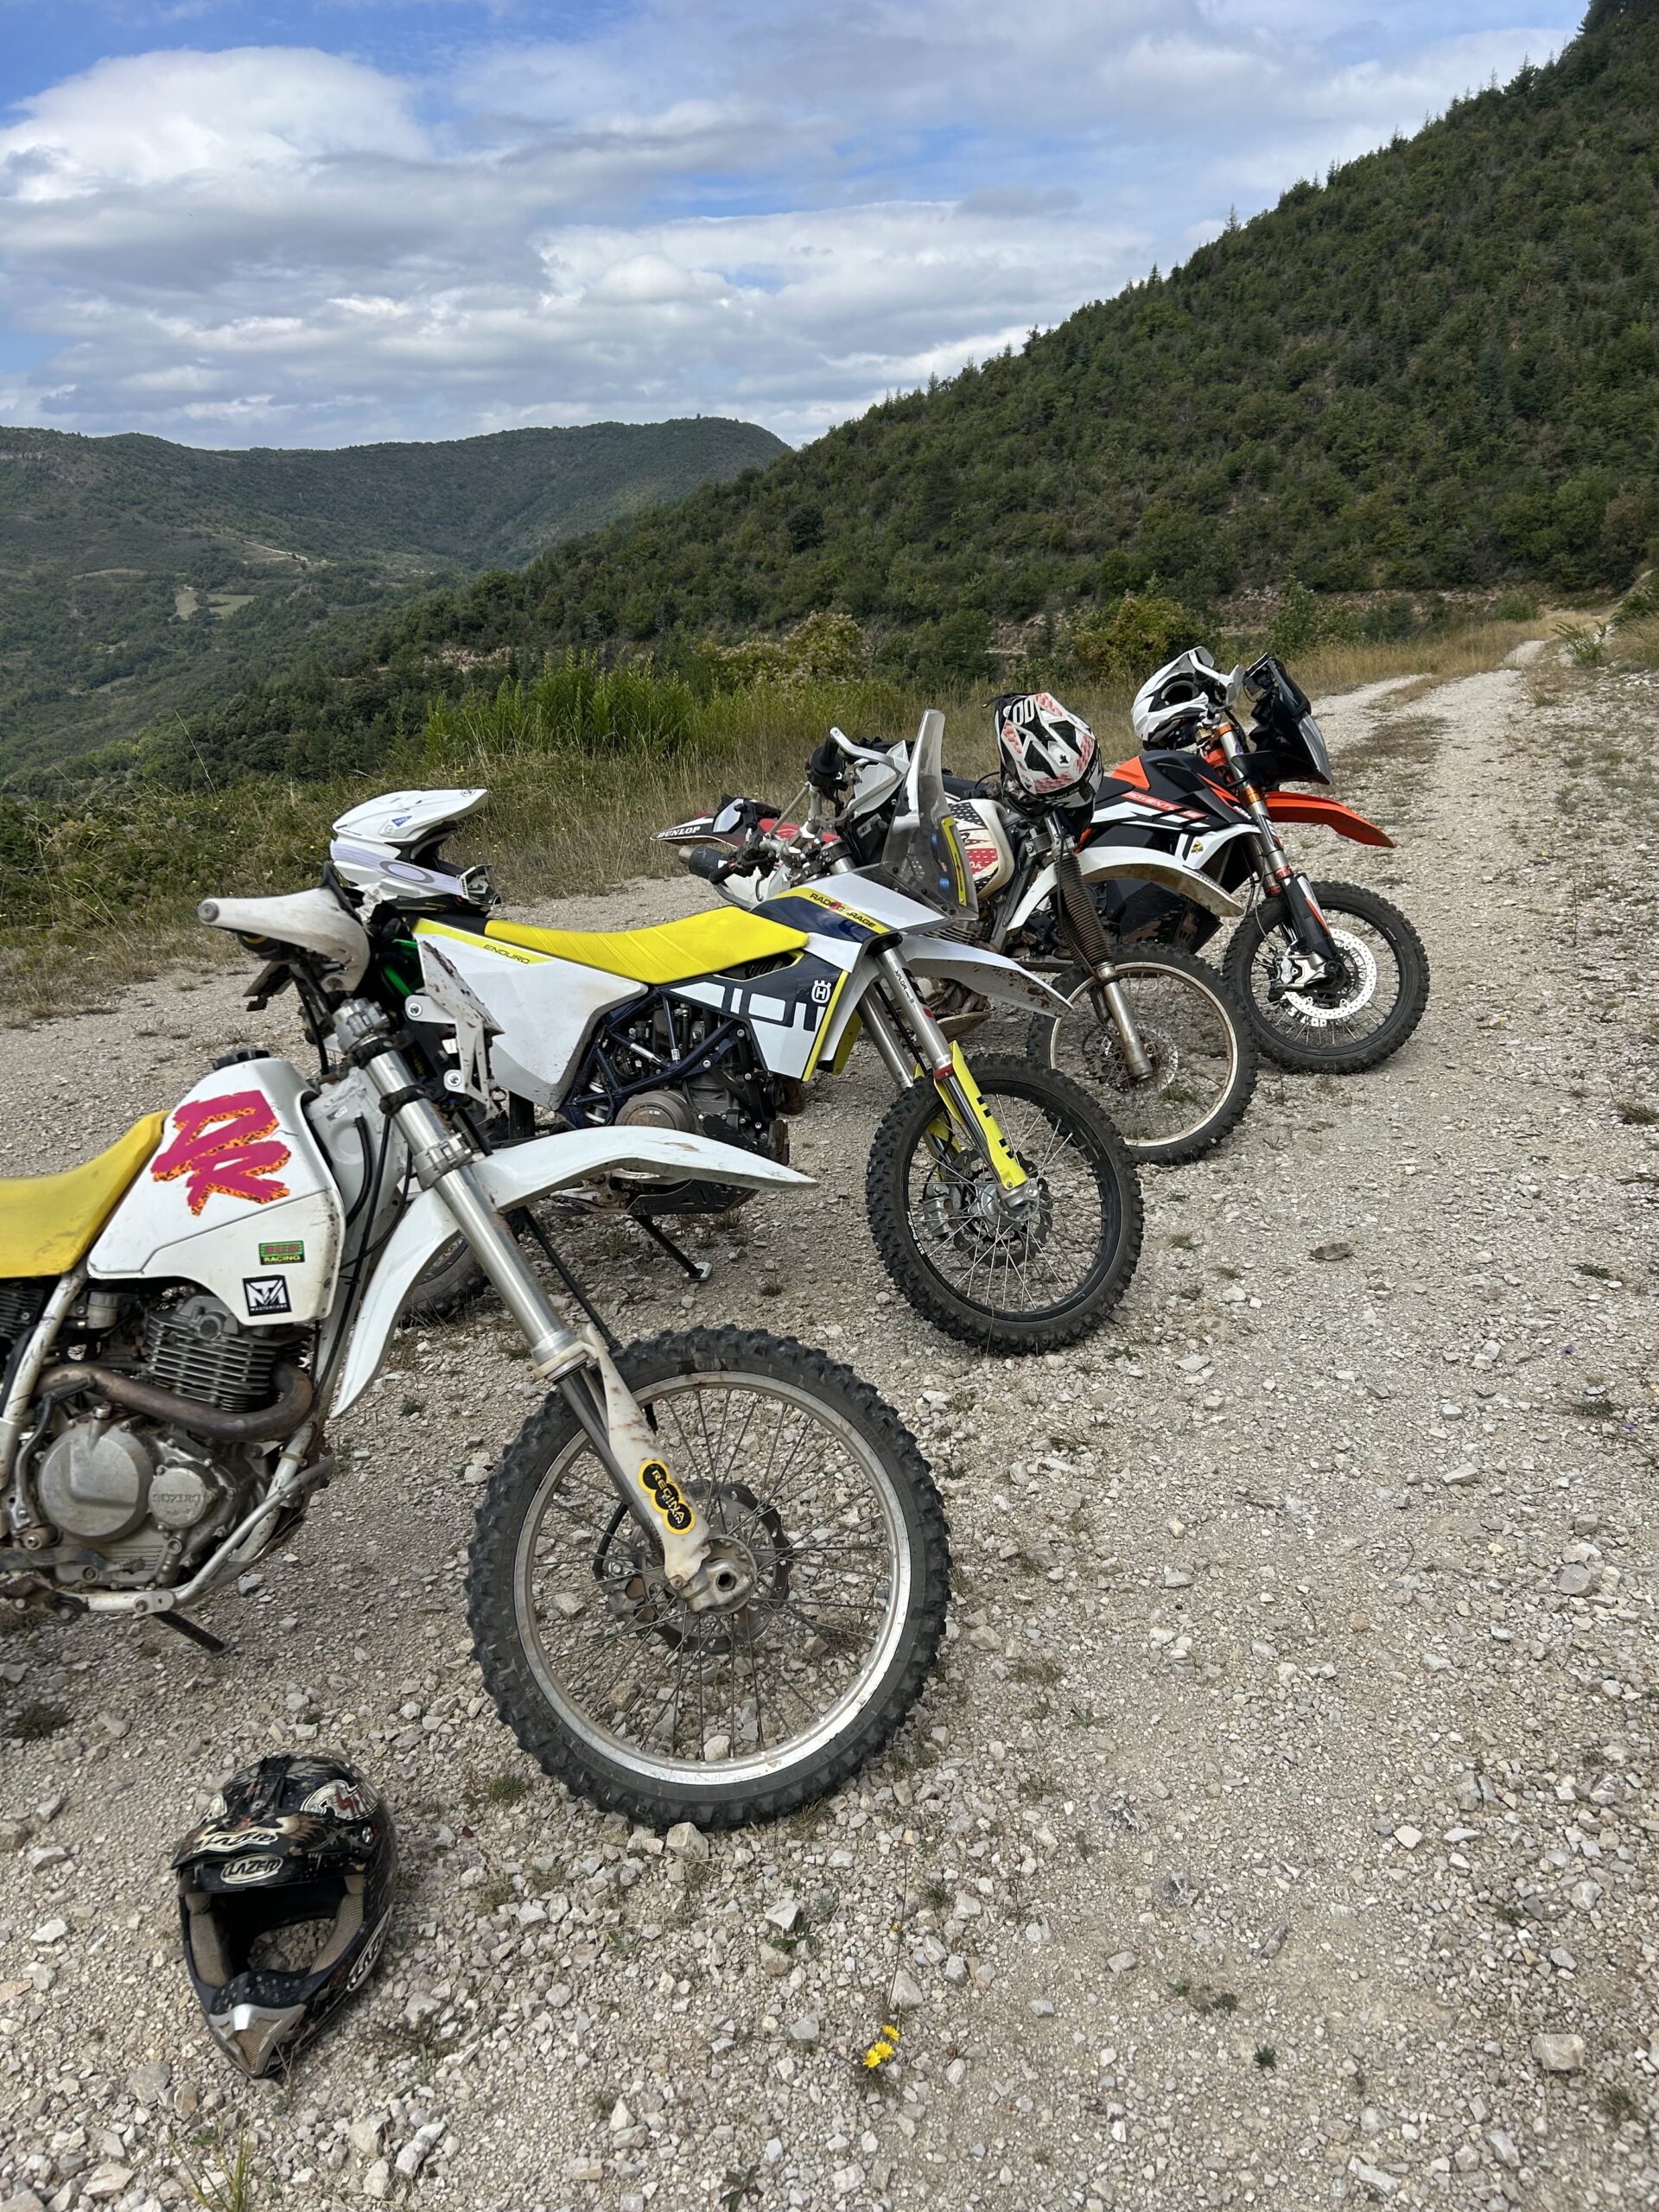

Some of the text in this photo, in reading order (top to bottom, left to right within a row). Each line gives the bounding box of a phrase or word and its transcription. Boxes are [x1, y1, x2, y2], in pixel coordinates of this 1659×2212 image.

[657, 826, 701, 838] DUNLOP
[836, 905, 876, 928] GRAGE
[484, 944, 531, 964] ENDURO
[150, 1090, 291, 1217] DR
[152, 1493, 201, 1503] SUZUKI
[652, 1470, 684, 1521] REGINA
[228, 1859, 278, 1876] LAZER
